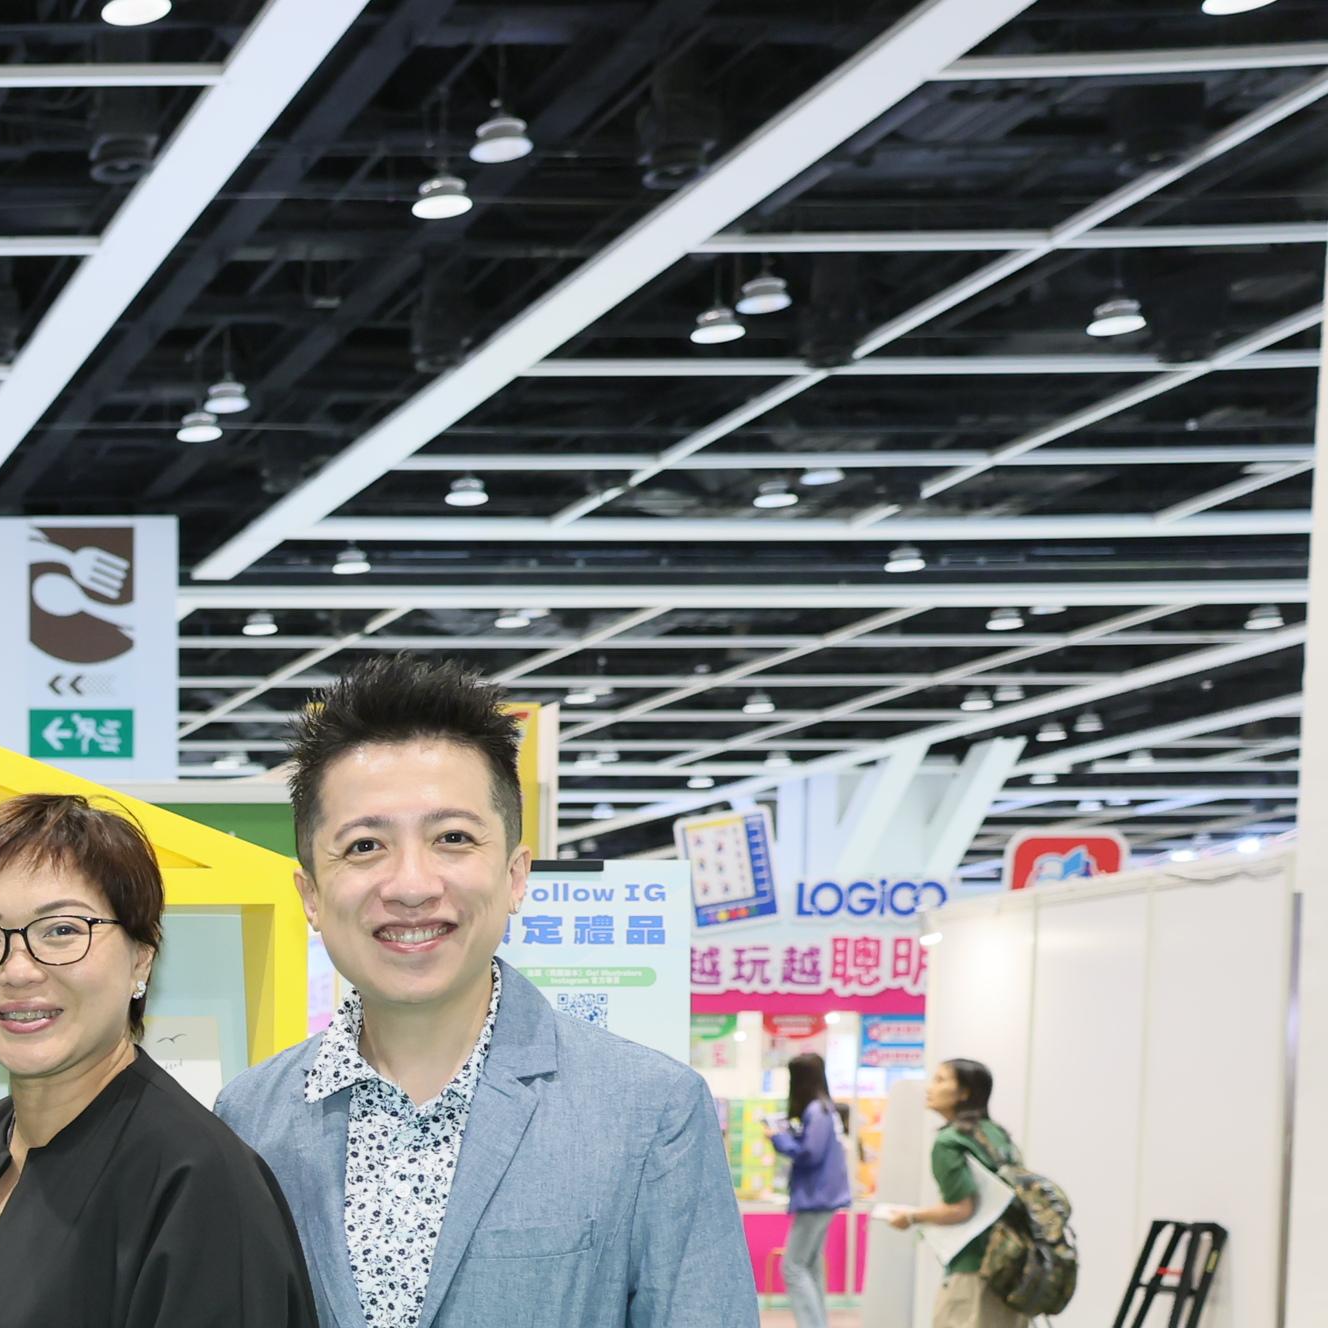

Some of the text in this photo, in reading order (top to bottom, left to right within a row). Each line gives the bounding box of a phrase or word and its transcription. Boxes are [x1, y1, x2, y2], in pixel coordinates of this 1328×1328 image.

[525, 883, 666, 902] ollow IG
[502, 915, 666, 945] 定禮品
